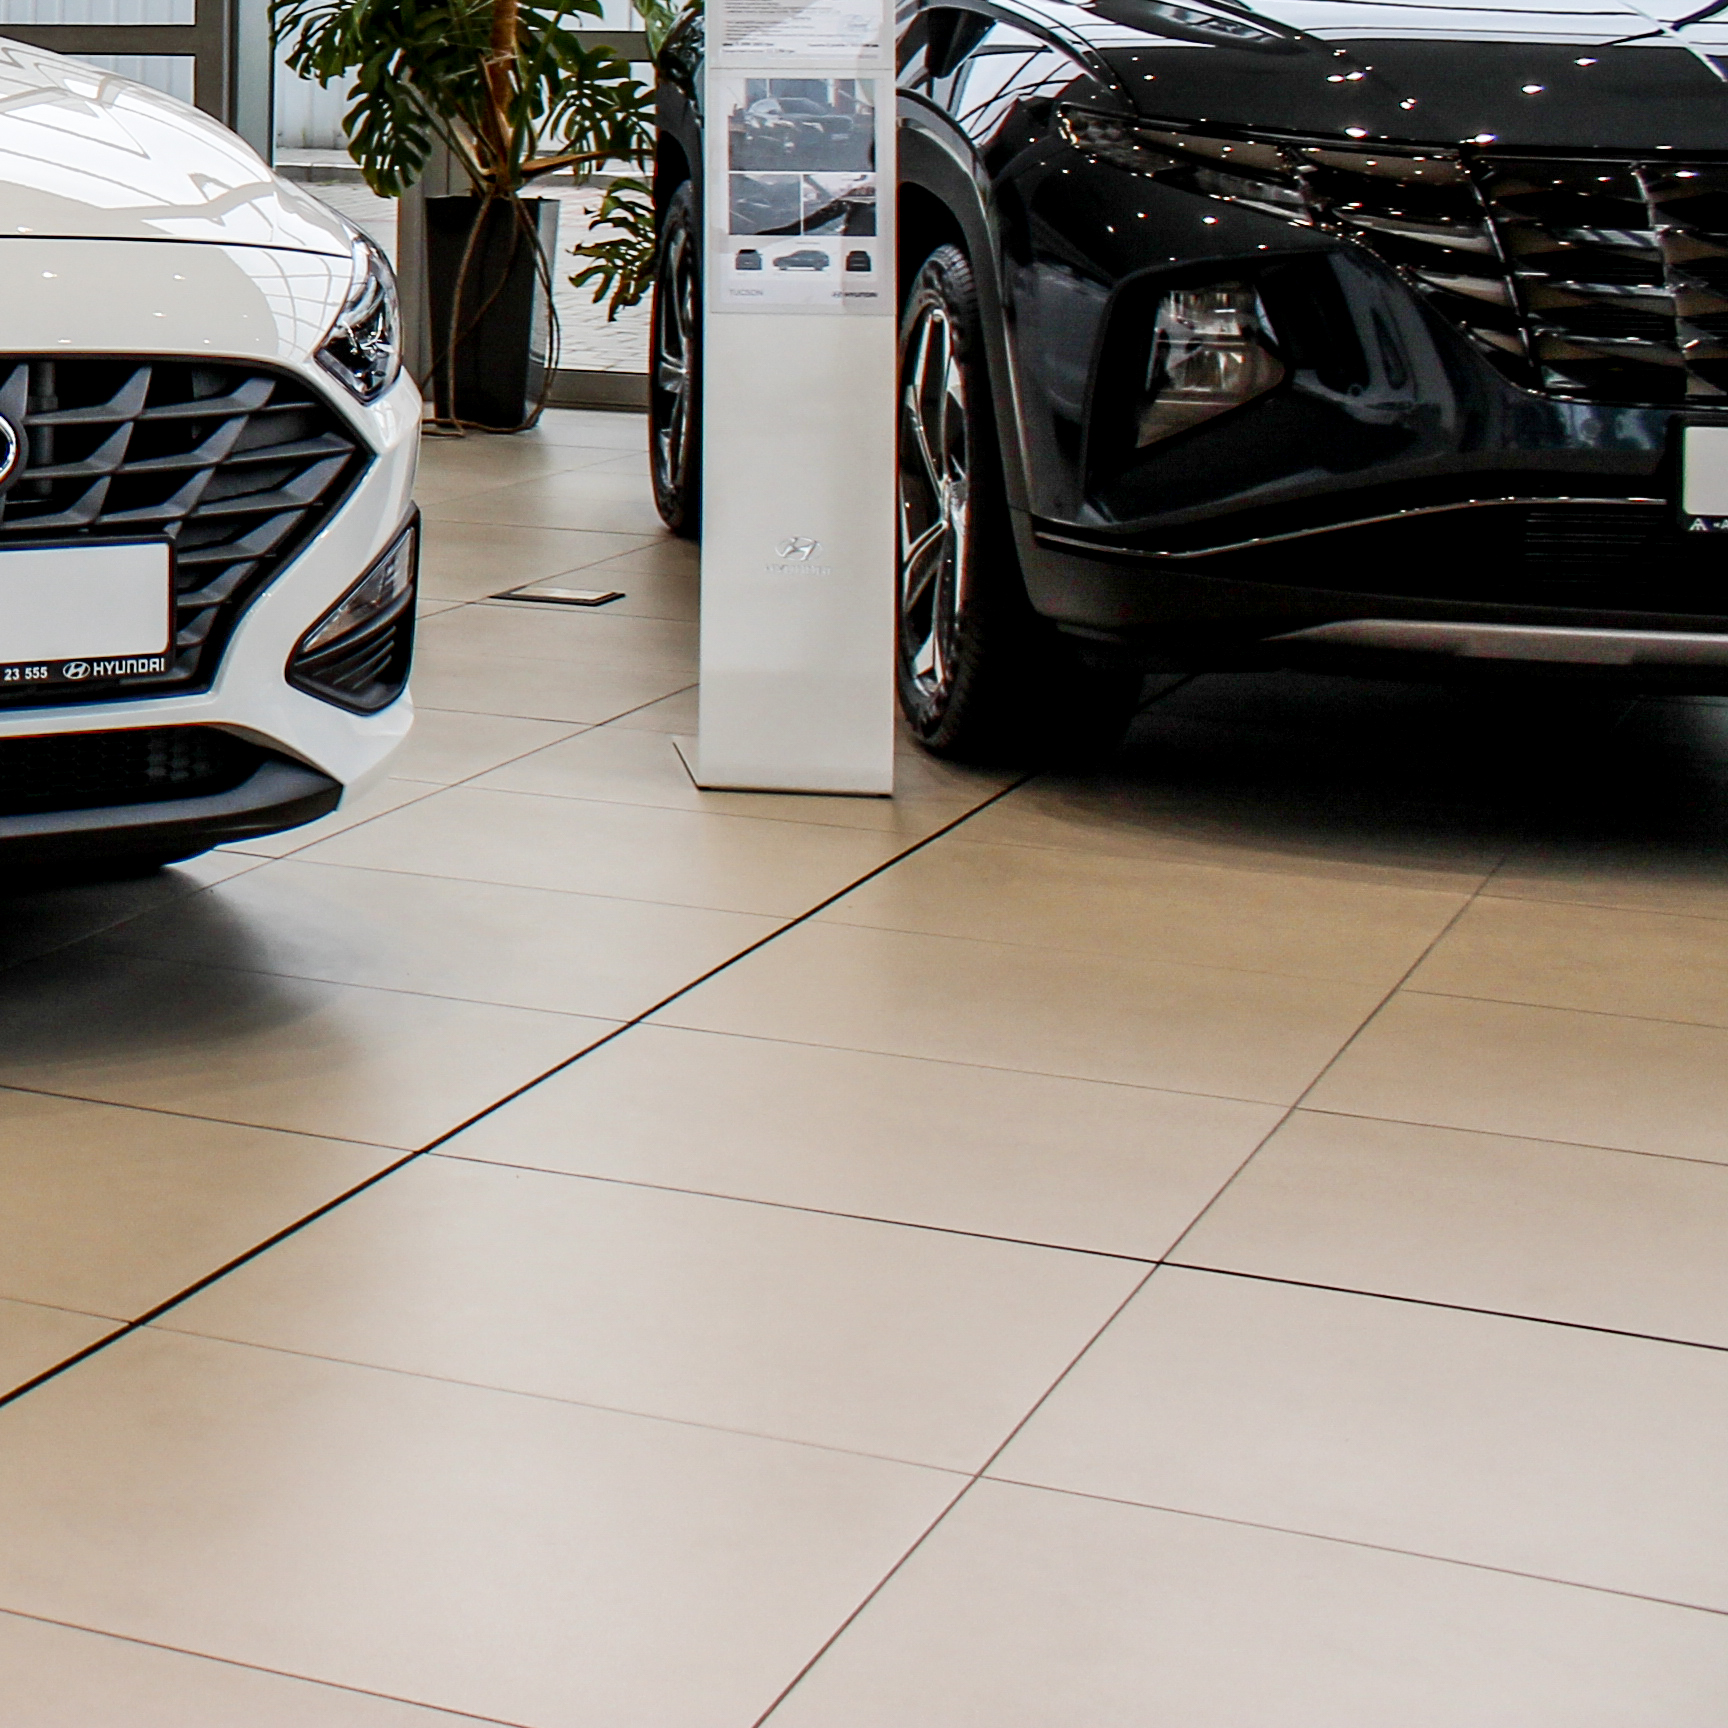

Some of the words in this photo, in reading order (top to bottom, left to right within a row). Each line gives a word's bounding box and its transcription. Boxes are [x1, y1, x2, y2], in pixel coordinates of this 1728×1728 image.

[4, 668, 20, 681] 23
[24, 666, 48, 679] 555
[93, 658, 165, 676] HYUNDAI
